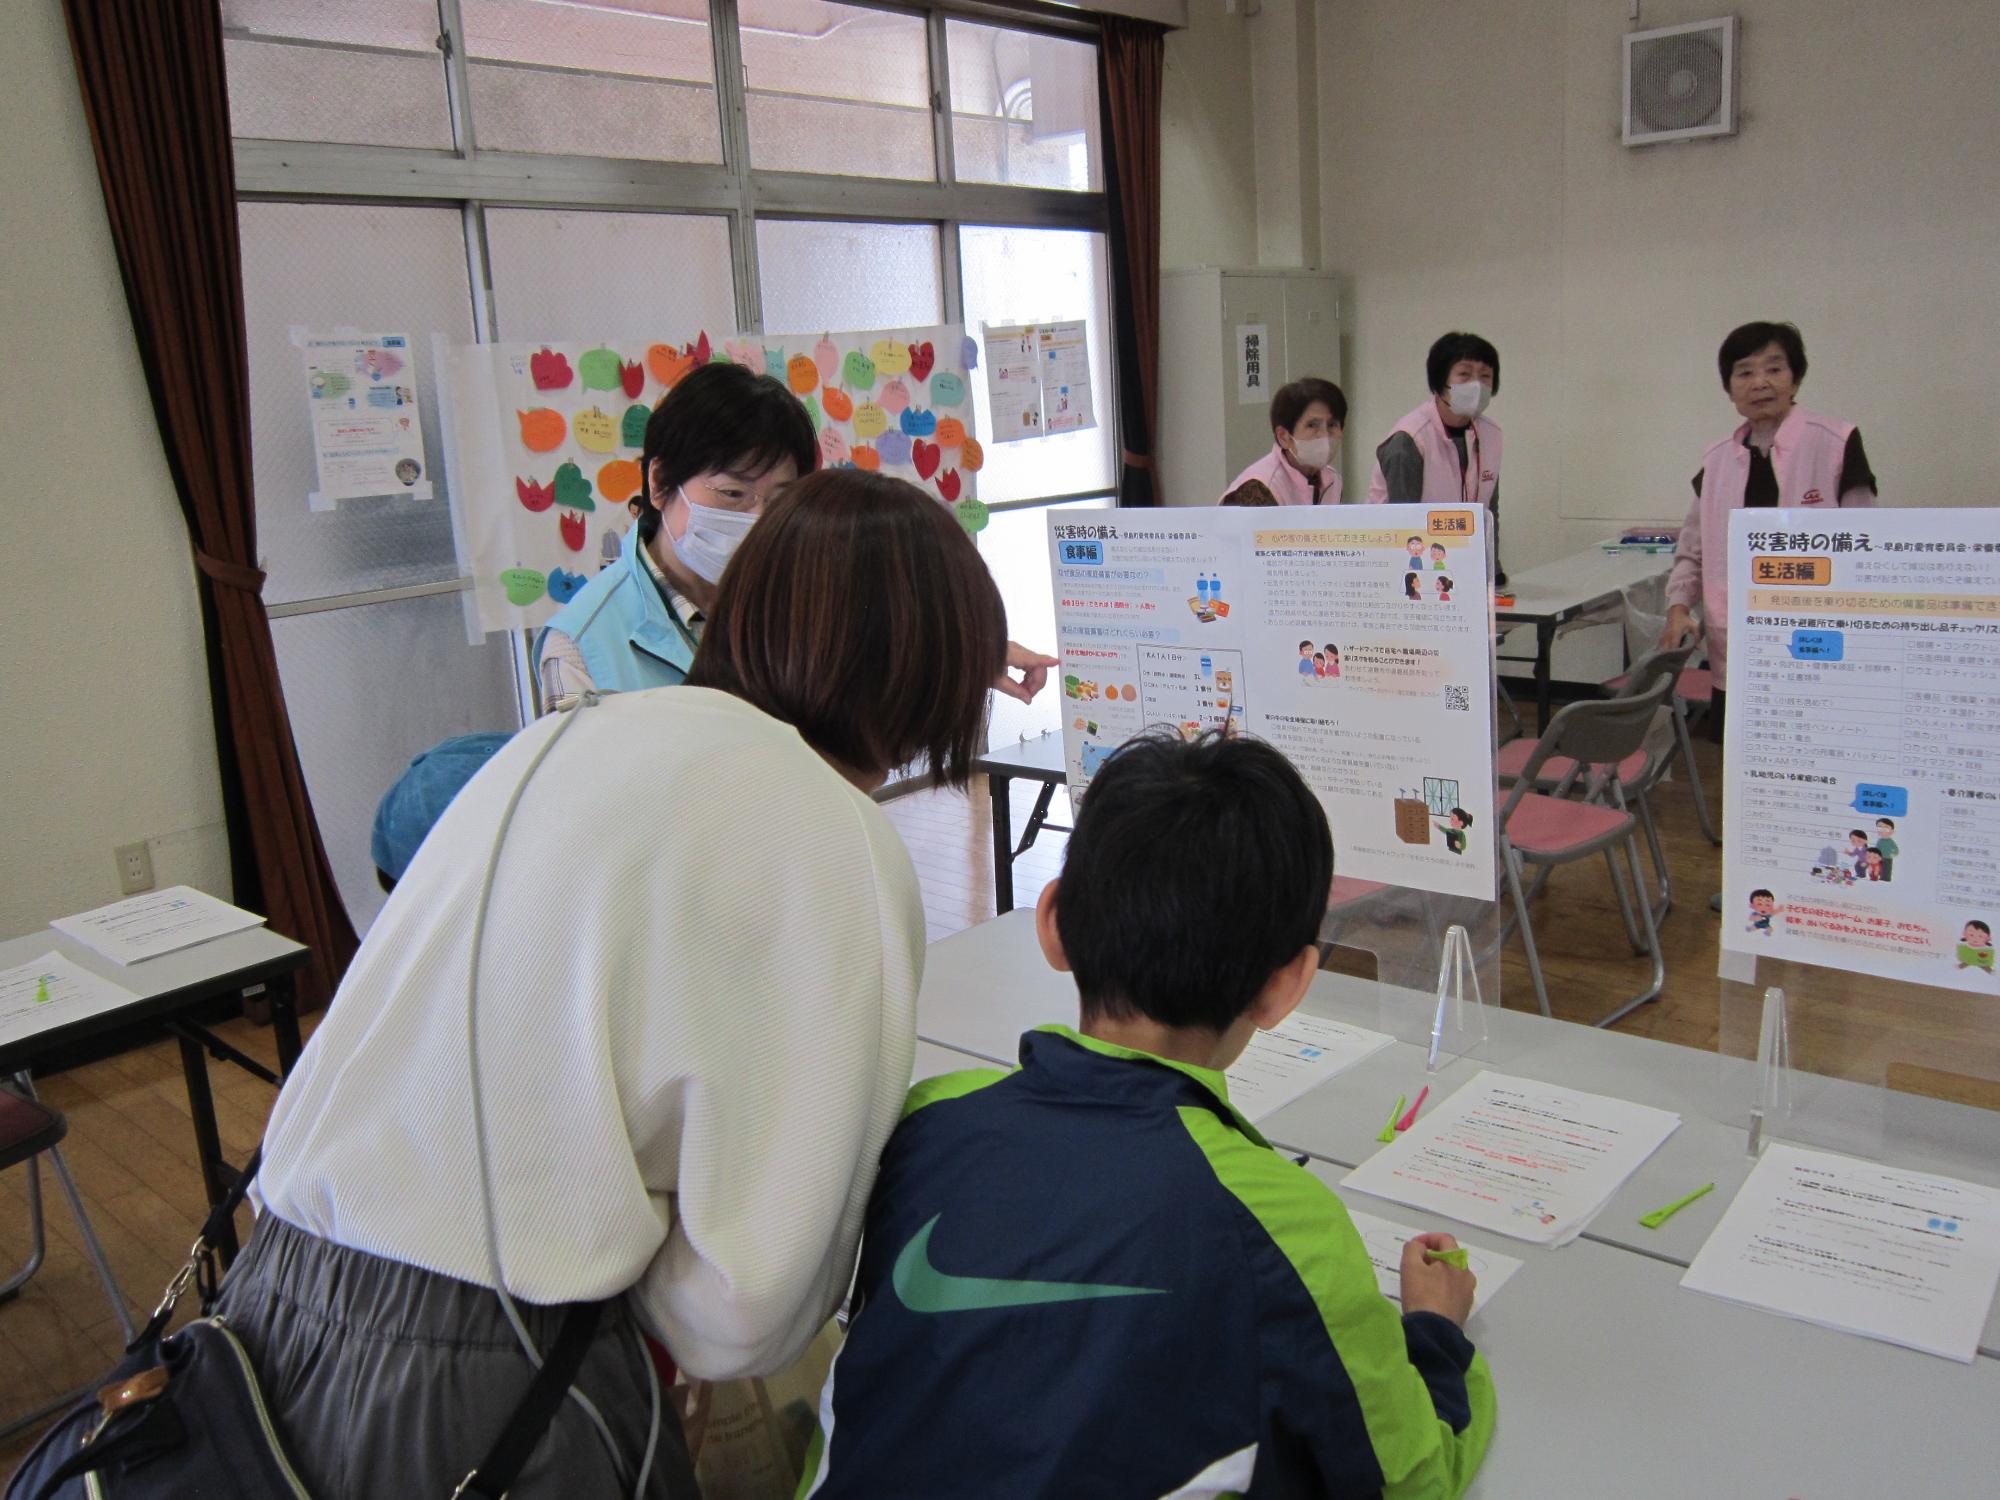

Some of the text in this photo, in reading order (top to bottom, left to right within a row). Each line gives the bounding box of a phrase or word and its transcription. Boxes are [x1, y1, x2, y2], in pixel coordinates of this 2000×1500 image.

[1245, 334, 1260, 388] 掃除用具
[1054, 525, 1119, 540] 災害時の備え
[1432, 518, 1467, 531] 生活編
[1747, 532, 1873, 553] 災害時の備え
[1065, 545, 1098, 560] 食事編
[1759, 562, 1815, 580] 生活編
